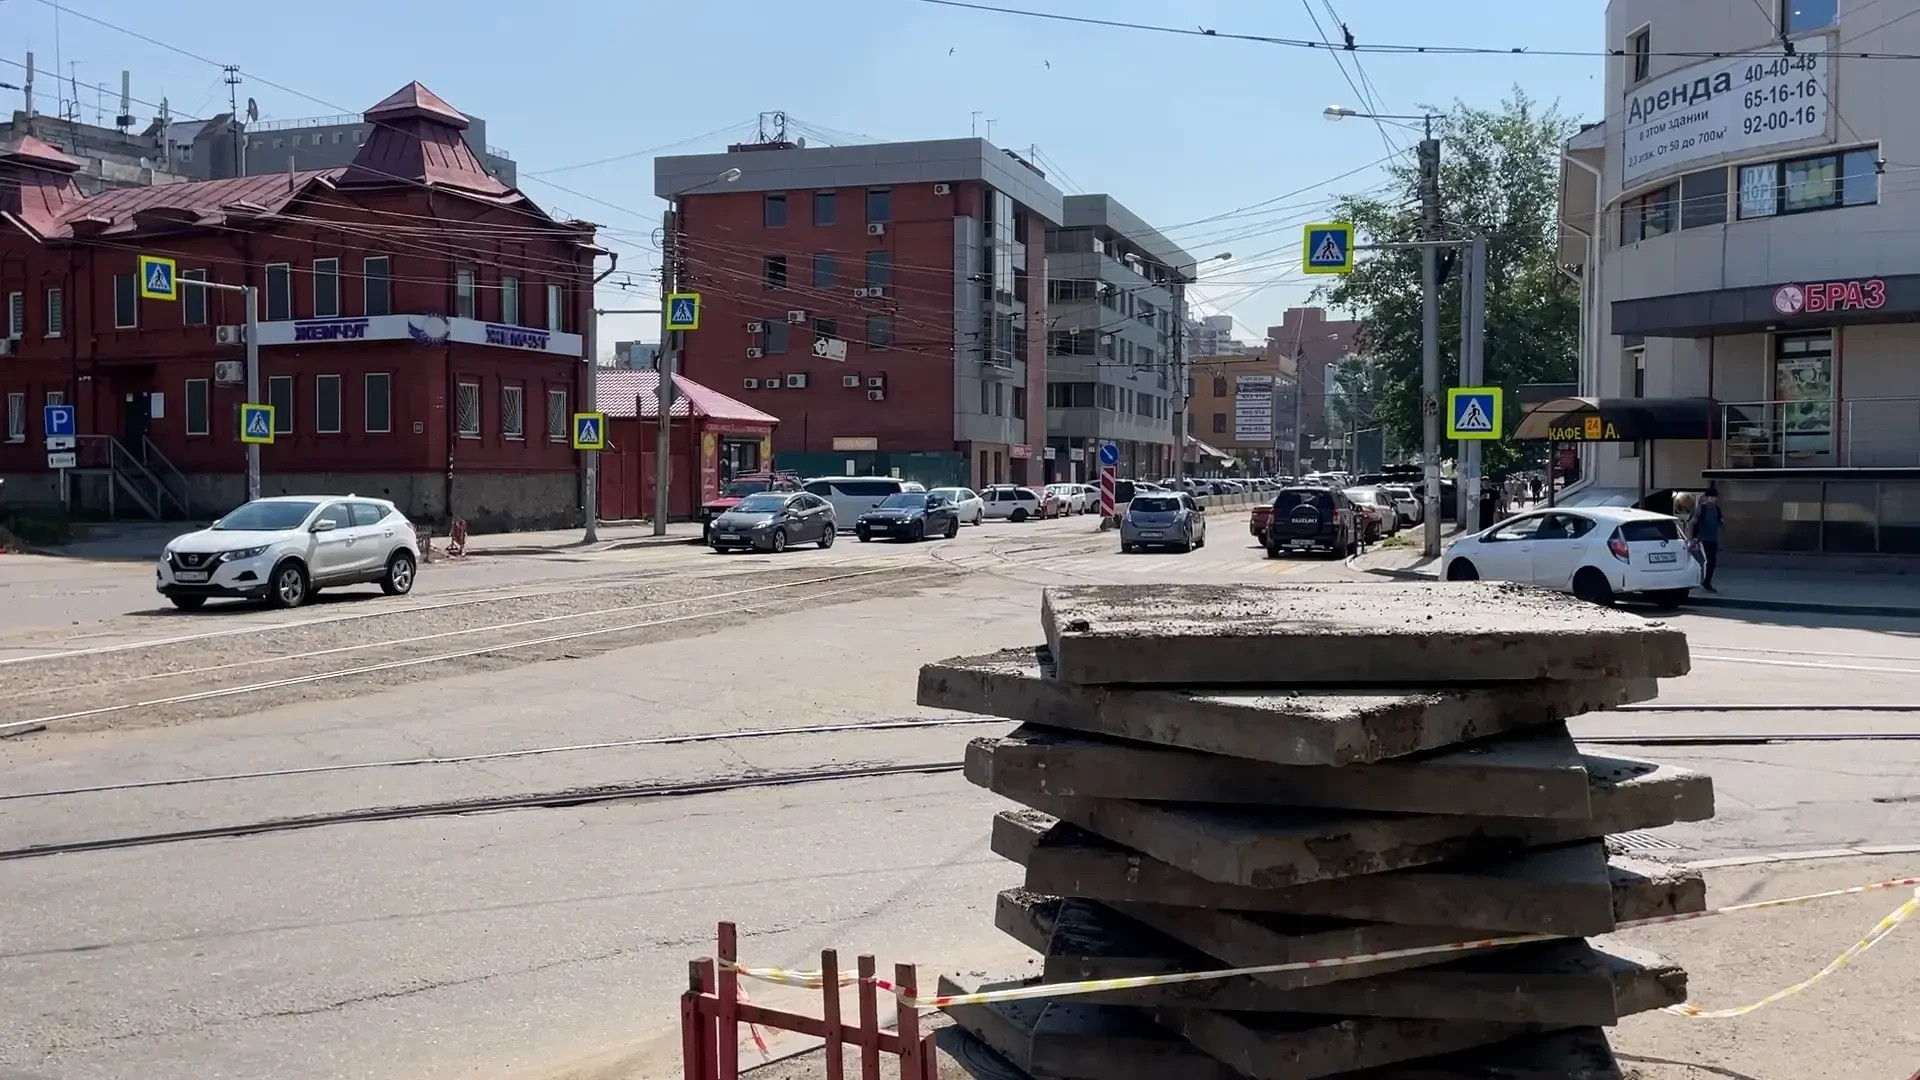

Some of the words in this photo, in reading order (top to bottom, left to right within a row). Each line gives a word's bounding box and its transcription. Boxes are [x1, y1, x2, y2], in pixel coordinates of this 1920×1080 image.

[1744, 53, 1817, 83] 40-40-48
[1628, 72, 1732, 124] Аренда
[1744, 79, 1817, 110] 65-16-16
[1639, 130, 1645, 141] в
[1645, 123, 1666, 139] этом
[1668, 110, 1709, 129] здании
[1743, 105, 1816, 135] 92-00-16
[1657, 144, 1668, 156] От
[1669, 139, 1680, 152] 50
[1681, 138, 1696, 151] до
[294, 323, 370, 341] ЖЕМЧУГ
[52, 409, 69, 433] P
[1548, 425, 1582, 440] КАФЕ
[1586, 419, 1599, 431] 24
